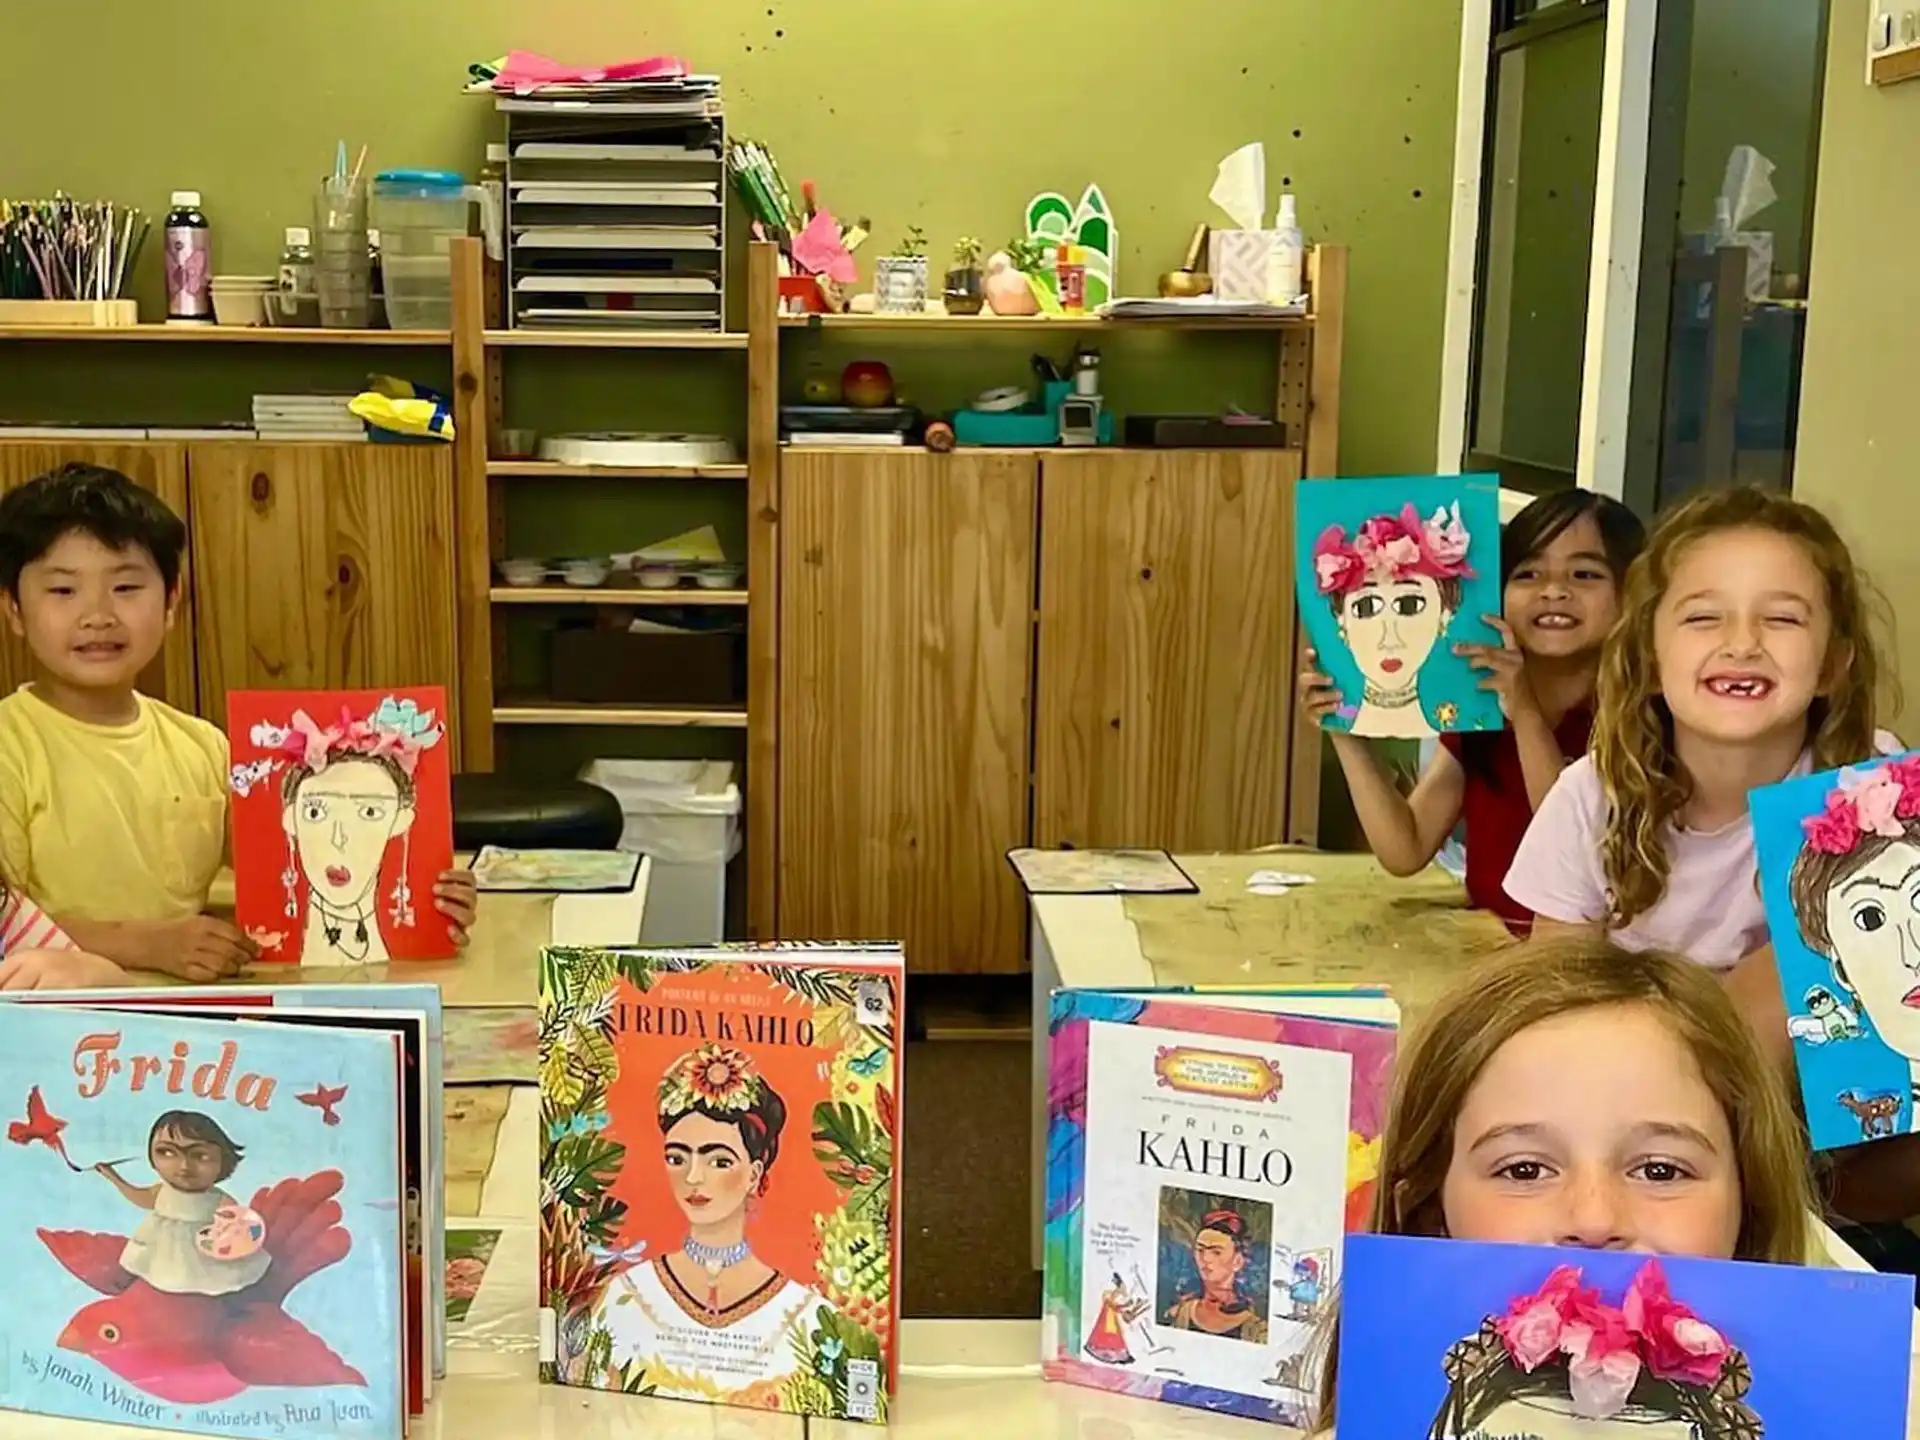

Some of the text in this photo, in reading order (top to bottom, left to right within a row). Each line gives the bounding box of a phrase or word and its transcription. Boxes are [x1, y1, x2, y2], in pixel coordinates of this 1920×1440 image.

[618, 1003, 815, 1049] FRIDA KAHLO
[73, 1031, 278, 1112] Frida
[1161, 1115, 1270, 1140] FRIDA
[1136, 1129, 1293, 1187] KAHLO
[22, 1350, 40, 1375] by
[39, 1354, 96, 1396] Jonah
[102, 1381, 171, 1421] Winter
[264, 1410, 287, 1434] by
[283, 1403, 322, 1425] Ana
